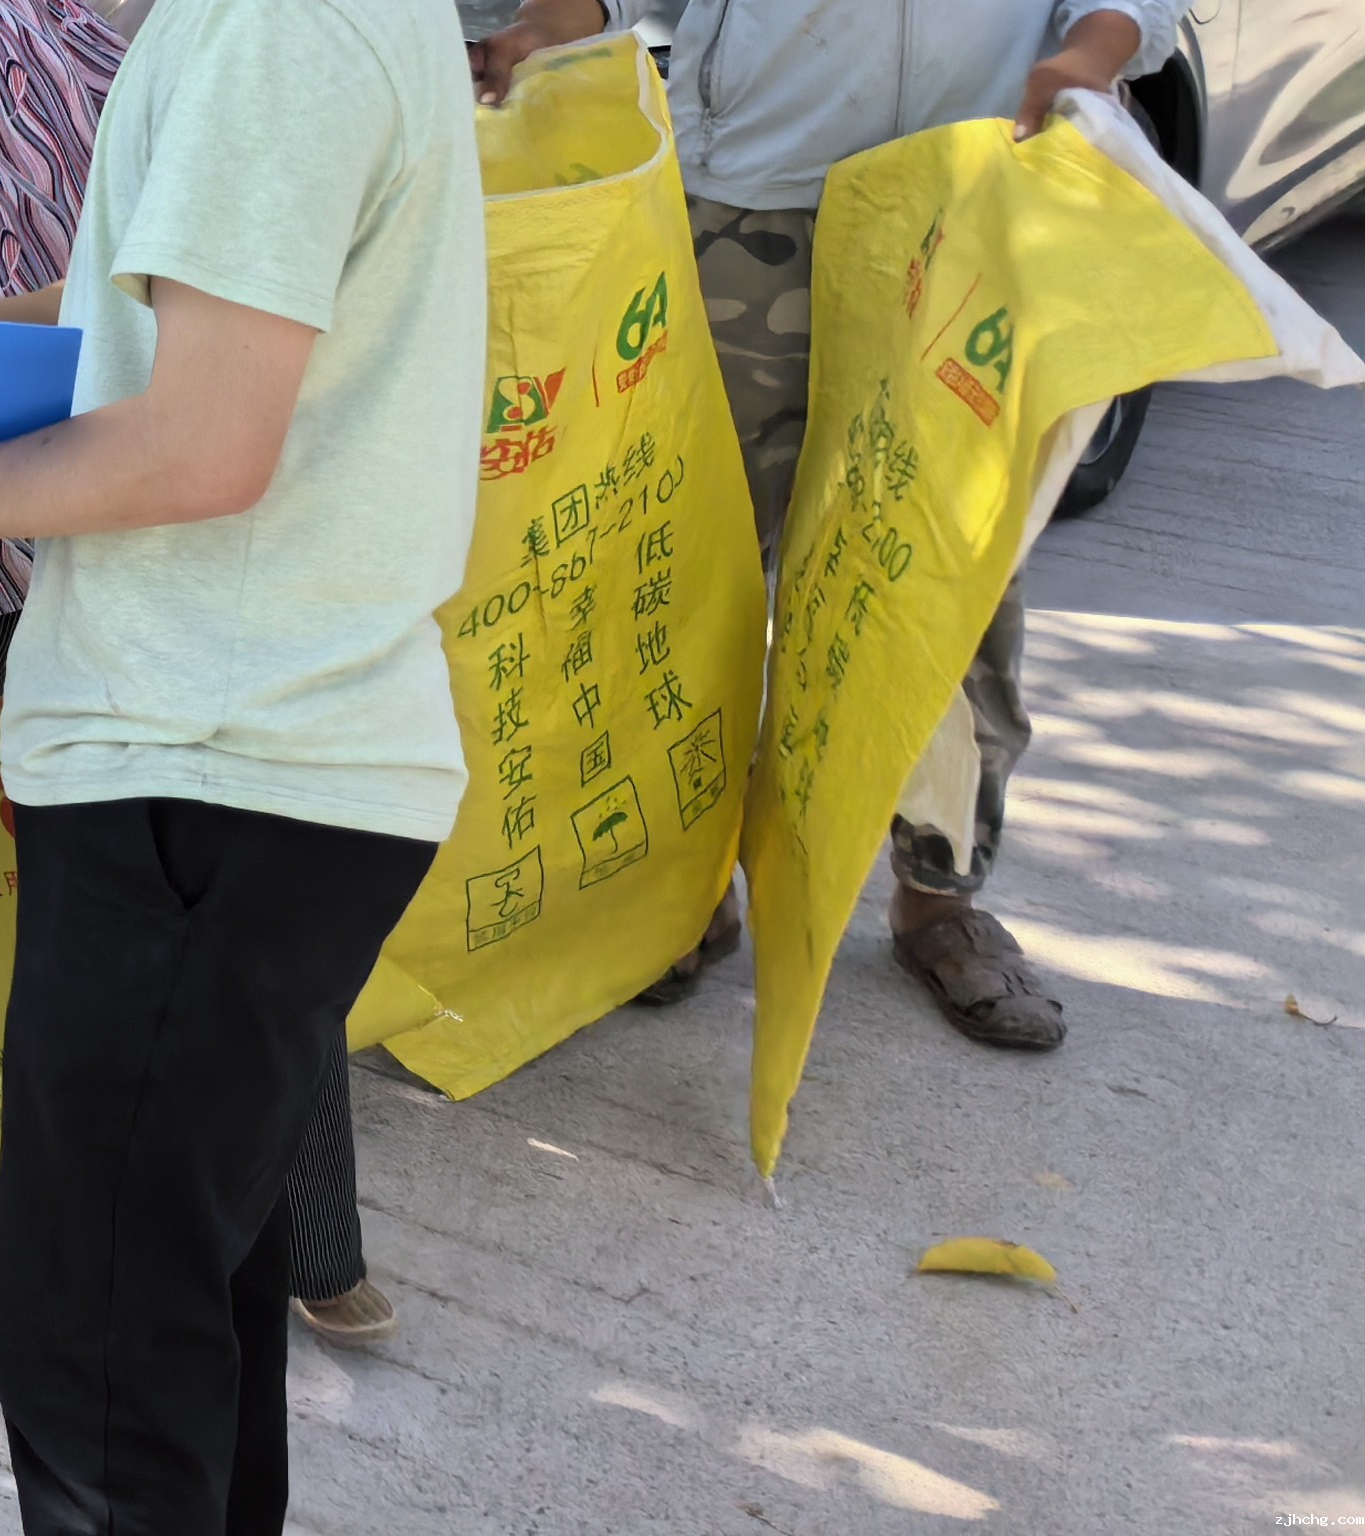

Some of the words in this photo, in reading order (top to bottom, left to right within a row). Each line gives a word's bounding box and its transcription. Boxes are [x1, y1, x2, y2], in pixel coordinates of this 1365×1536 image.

[617, 271, 668, 361] 6A
[520, 430, 656, 568] 集团热线
[561, 583, 612, 787] 幸福中国
[631, 521, 693, 730] 低碳地球
[488, 633, 536, 850] 科技安佑
